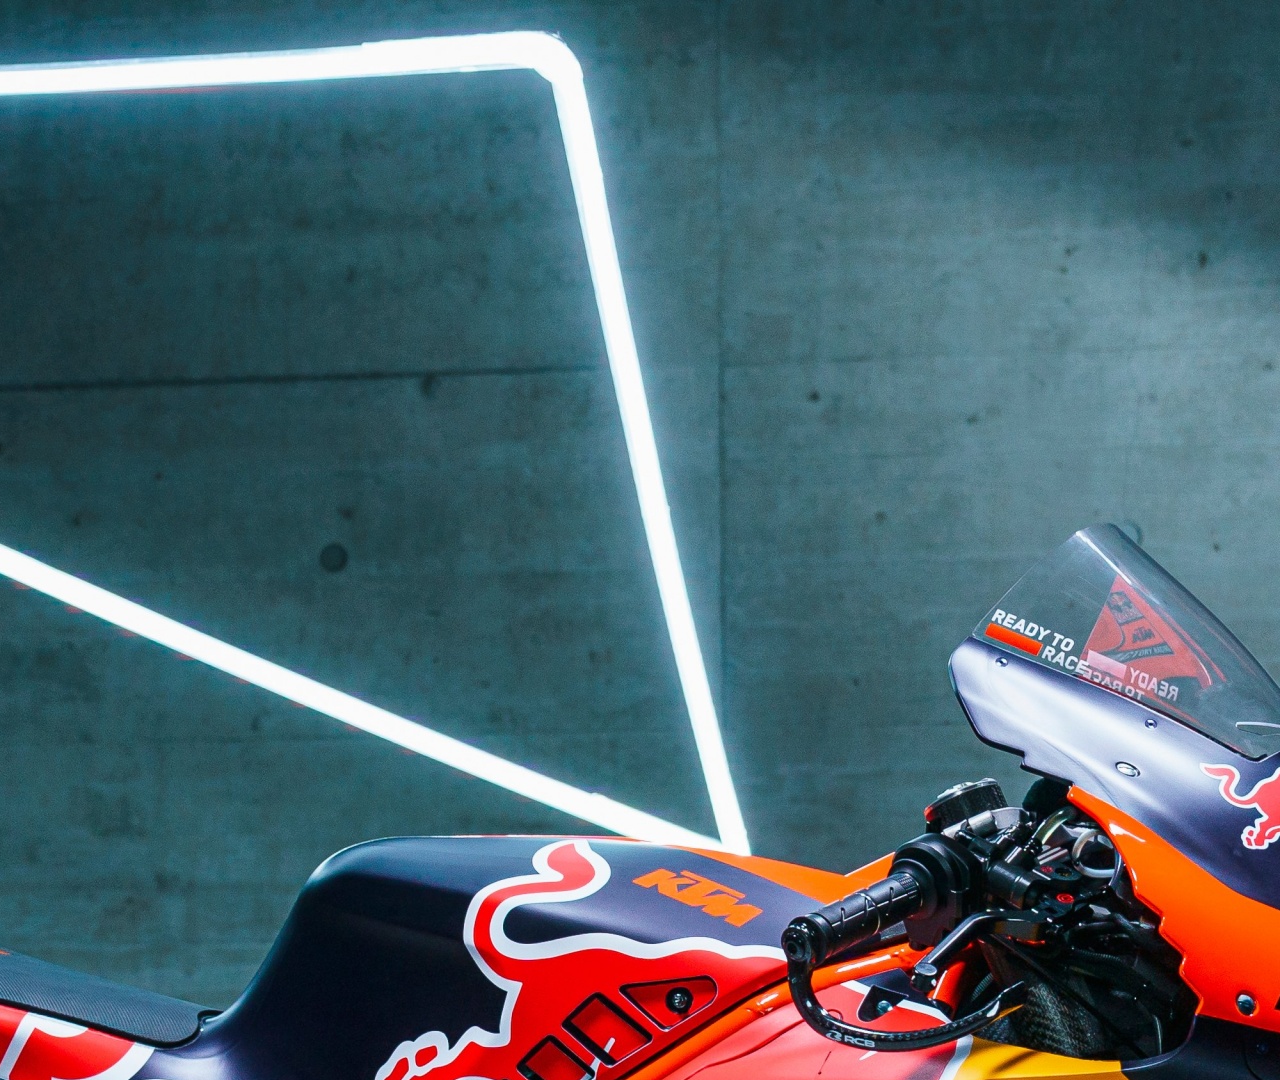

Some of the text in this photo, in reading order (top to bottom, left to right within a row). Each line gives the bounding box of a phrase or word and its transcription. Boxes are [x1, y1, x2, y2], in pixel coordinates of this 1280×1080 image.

[991, 609, 1075, 651] READY TO
[1042, 648, 1090, 675] RACE
[632, 867, 764, 928] KTM
[844, 1036, 875, 1048] RCB
